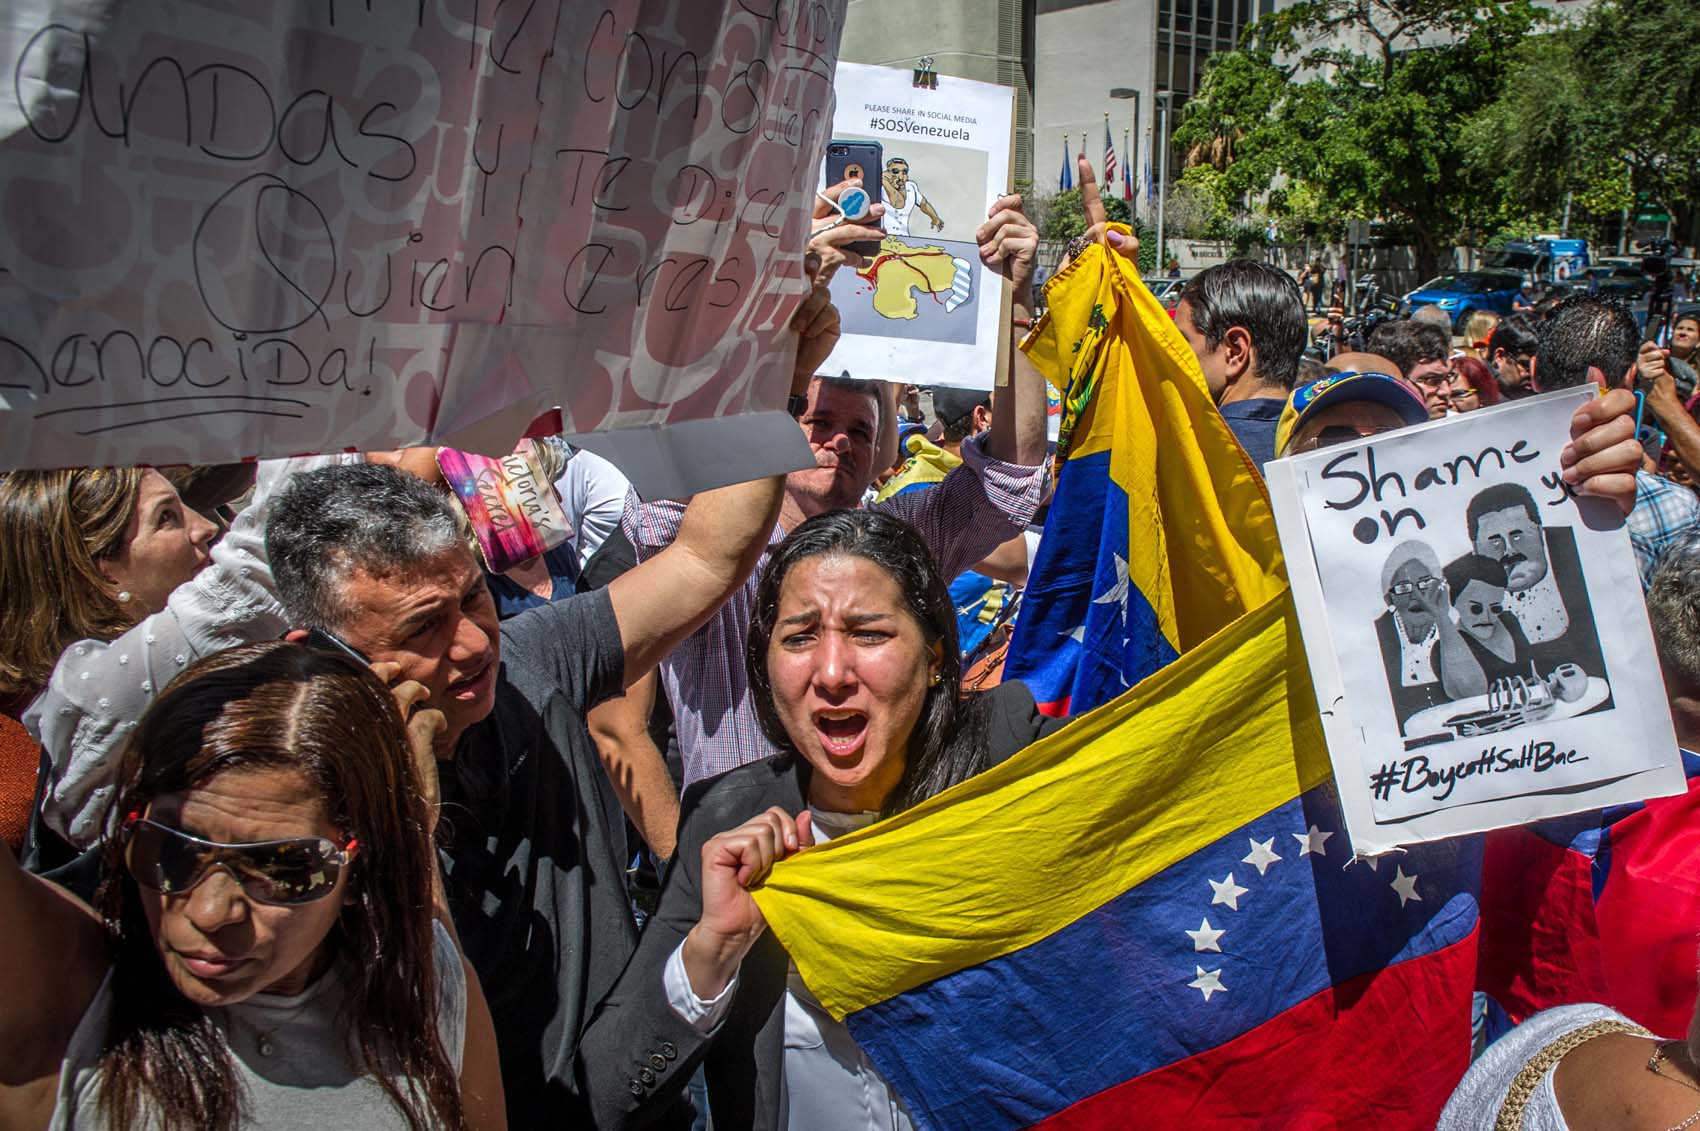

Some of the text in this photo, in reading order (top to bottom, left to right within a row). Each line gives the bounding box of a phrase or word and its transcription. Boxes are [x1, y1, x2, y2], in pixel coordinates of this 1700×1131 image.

[864, 103, 890, 113] PLEASE
[892, 106, 916, 116] SHARE
[927, 111, 952, 121] SOCIAL
[953, 115, 977, 125] MEDIA
[870, 117, 970, 141] #SOSVenezuela
[468, 466, 519, 534] Secret
[1321, 440, 1540, 511] Shame
[1353, 507, 1426, 545] on
[1369, 739, 1590, 802] #BoycottSaltBae
